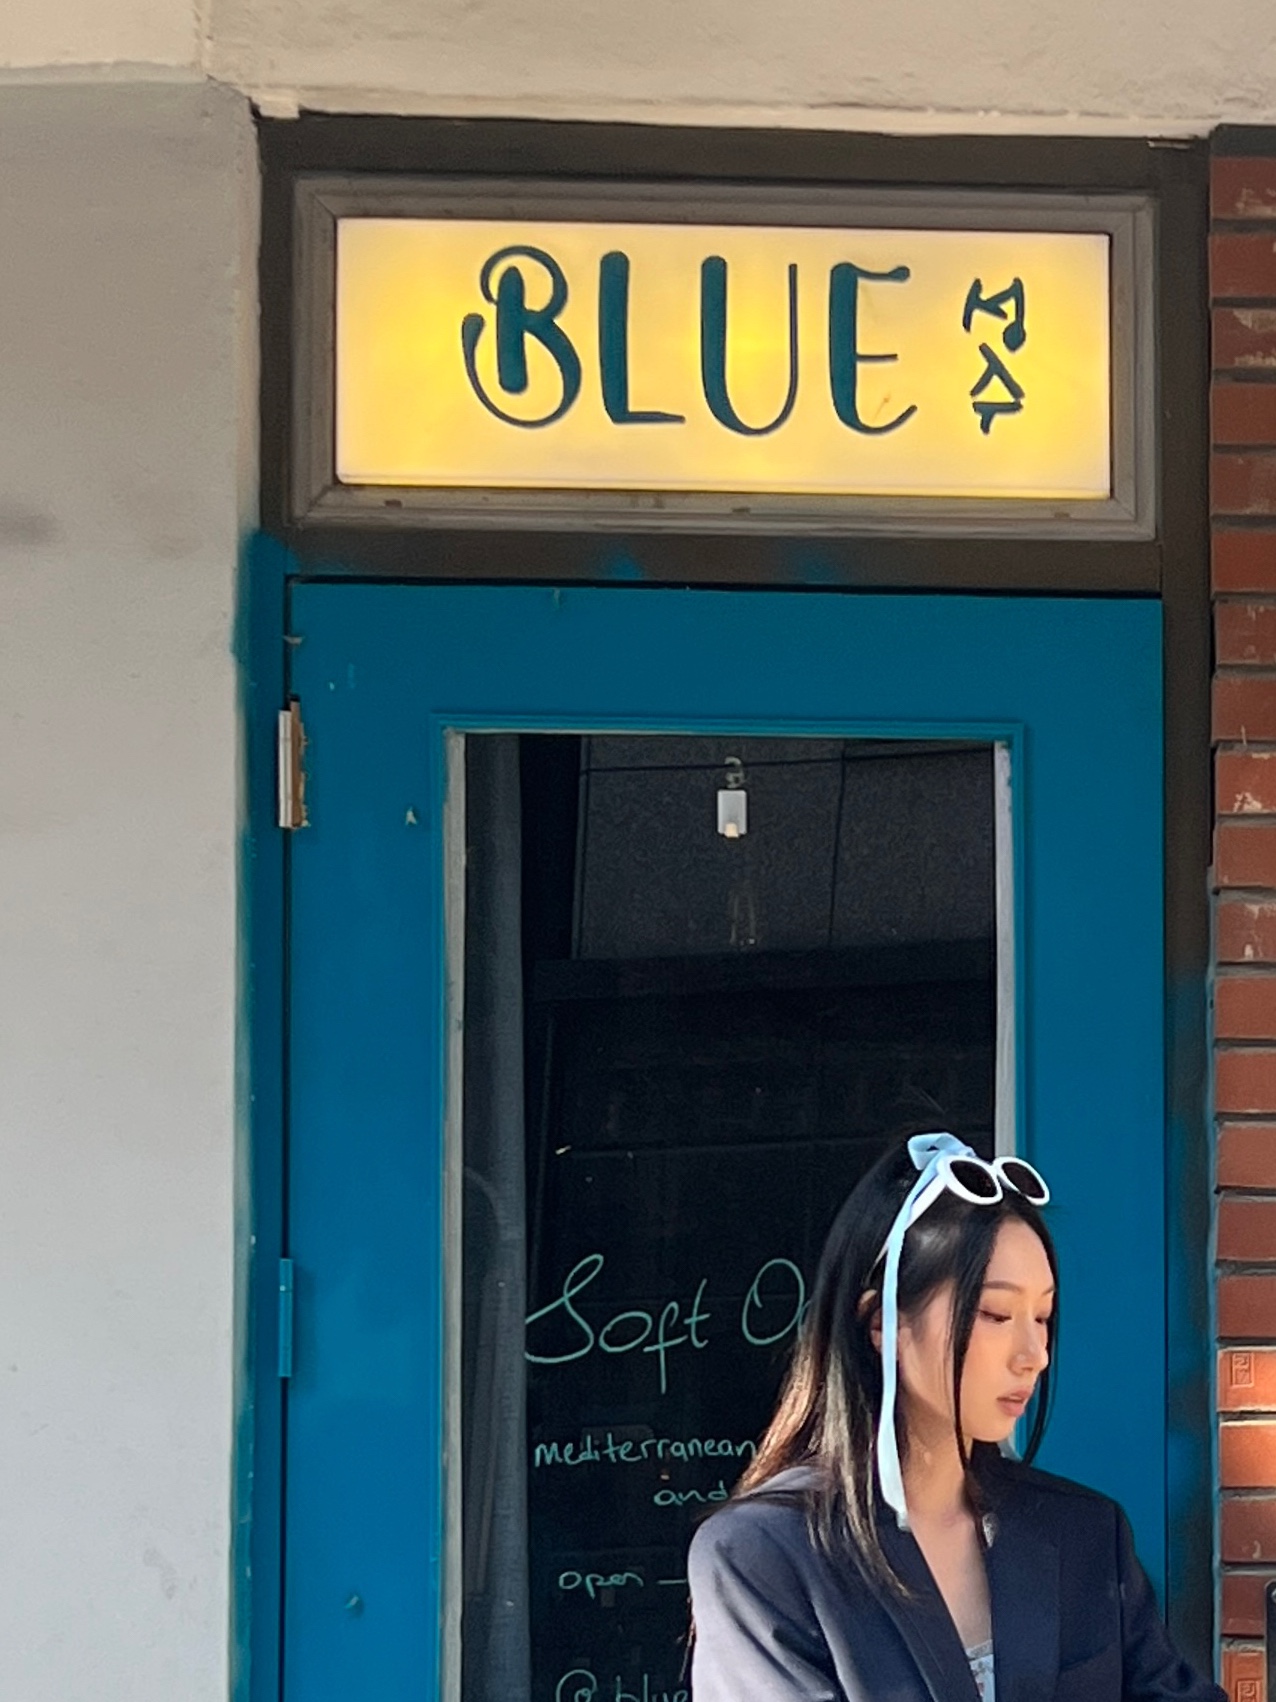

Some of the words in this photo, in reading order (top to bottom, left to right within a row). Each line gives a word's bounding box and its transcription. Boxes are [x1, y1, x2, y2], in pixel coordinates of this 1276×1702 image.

[461, 245, 917, 436] BLUE
[525, 1253, 710, 1395] Soft
[558, 1571, 644, 1597] open
